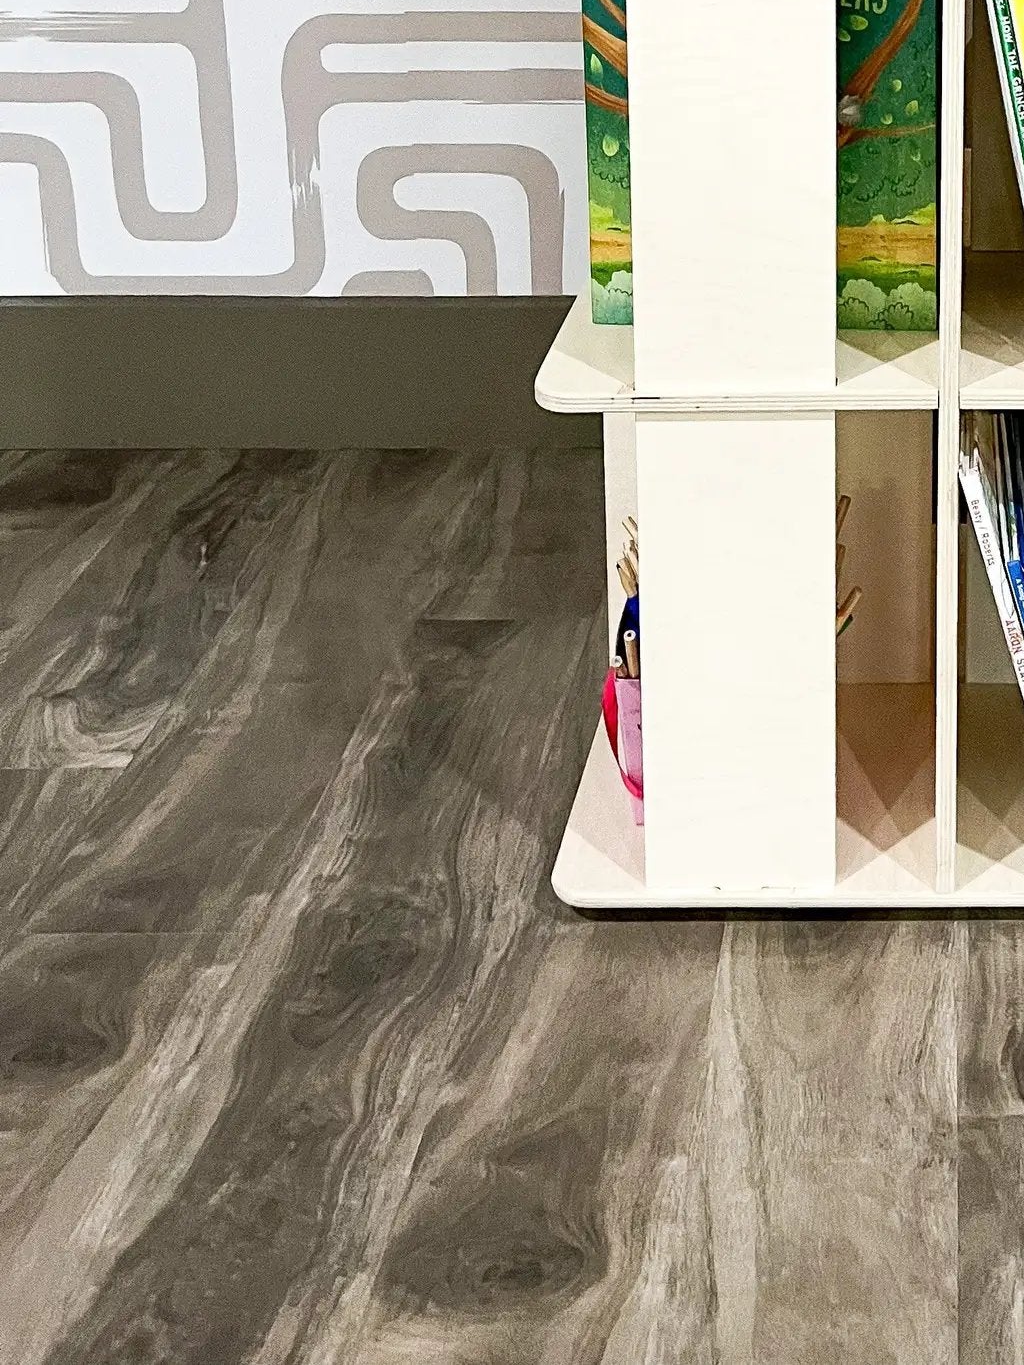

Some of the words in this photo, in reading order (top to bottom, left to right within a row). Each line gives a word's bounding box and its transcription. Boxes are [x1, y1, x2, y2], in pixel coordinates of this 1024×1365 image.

[1000, 15, 1014, 43] HOW
[1007, 49, 1020, 72] THE
[969, 499, 983, 524] Beaty
[1004, 618, 1024, 655] AARON
